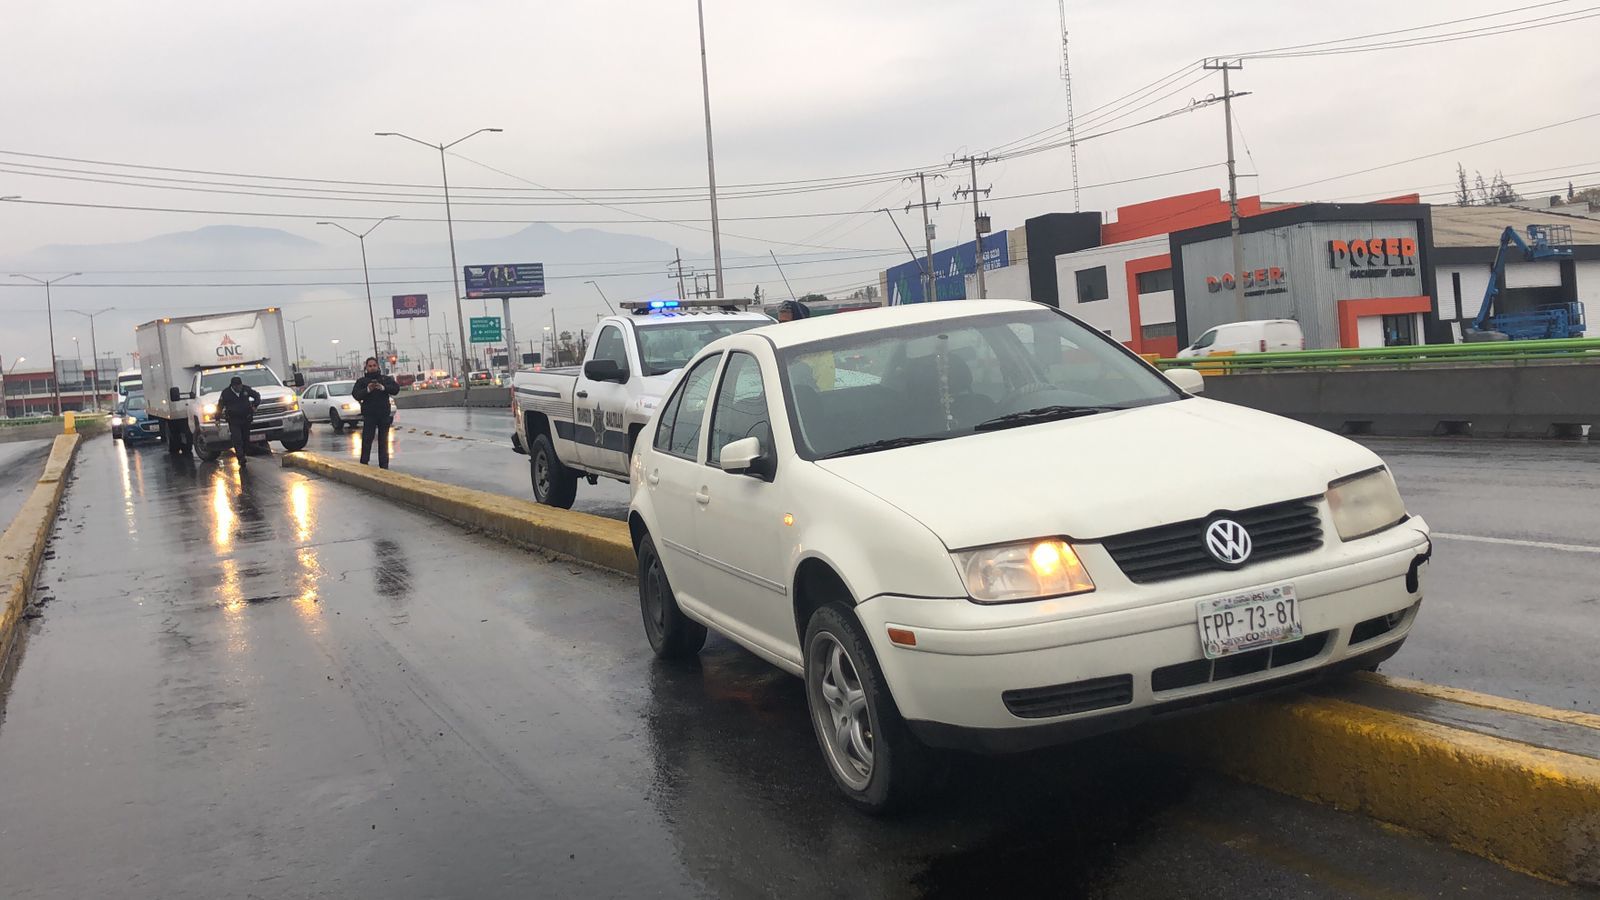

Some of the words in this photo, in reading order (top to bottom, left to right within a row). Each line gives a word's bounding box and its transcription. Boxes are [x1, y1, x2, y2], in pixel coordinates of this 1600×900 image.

[1330, 237, 1417, 269] DOSER
[216, 345, 243, 357] CNC
[606, 411, 624, 429] SALTILLO
[1202, 599, 1295, 640] FPP-73-87
